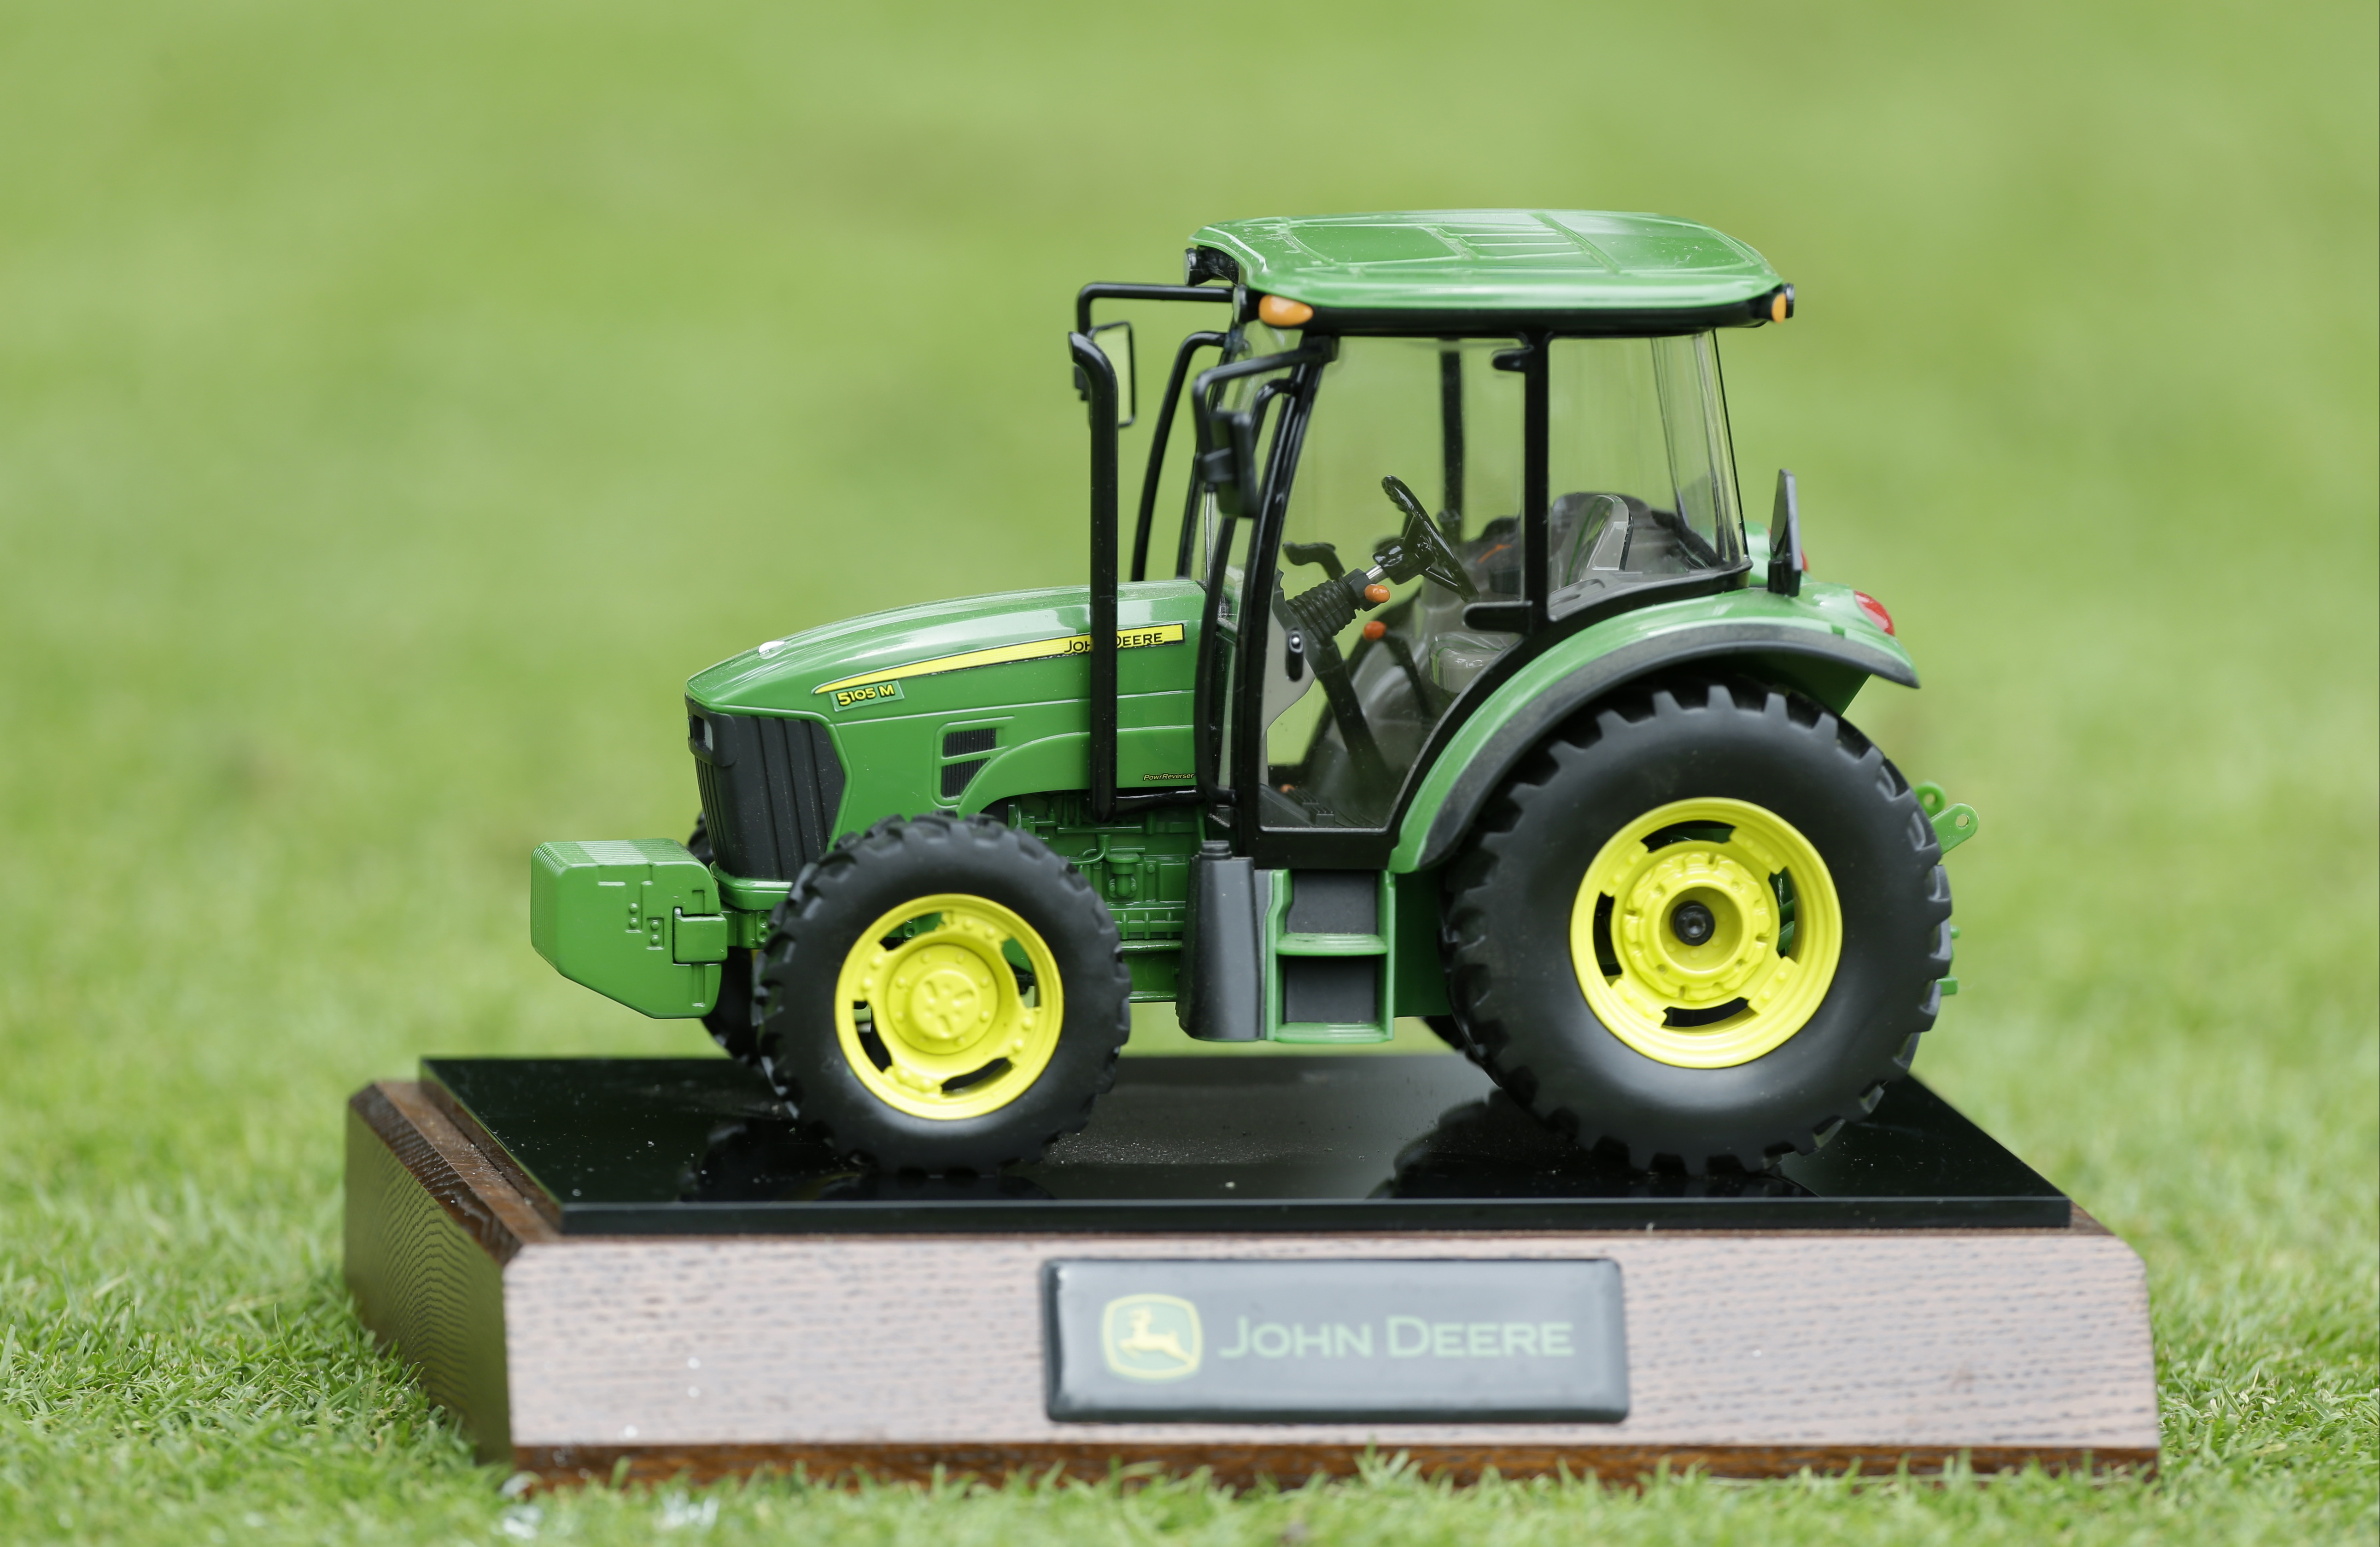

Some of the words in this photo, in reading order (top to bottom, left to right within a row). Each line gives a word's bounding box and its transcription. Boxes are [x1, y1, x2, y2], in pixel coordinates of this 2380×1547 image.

[1064, 640, 1090, 653] JOH
[836, 687, 877, 706] 5105
[878, 683, 895, 698] M
[1219, 1315, 1373, 1358] JOHN
[1387, 1315, 1575, 1358] DEERE
